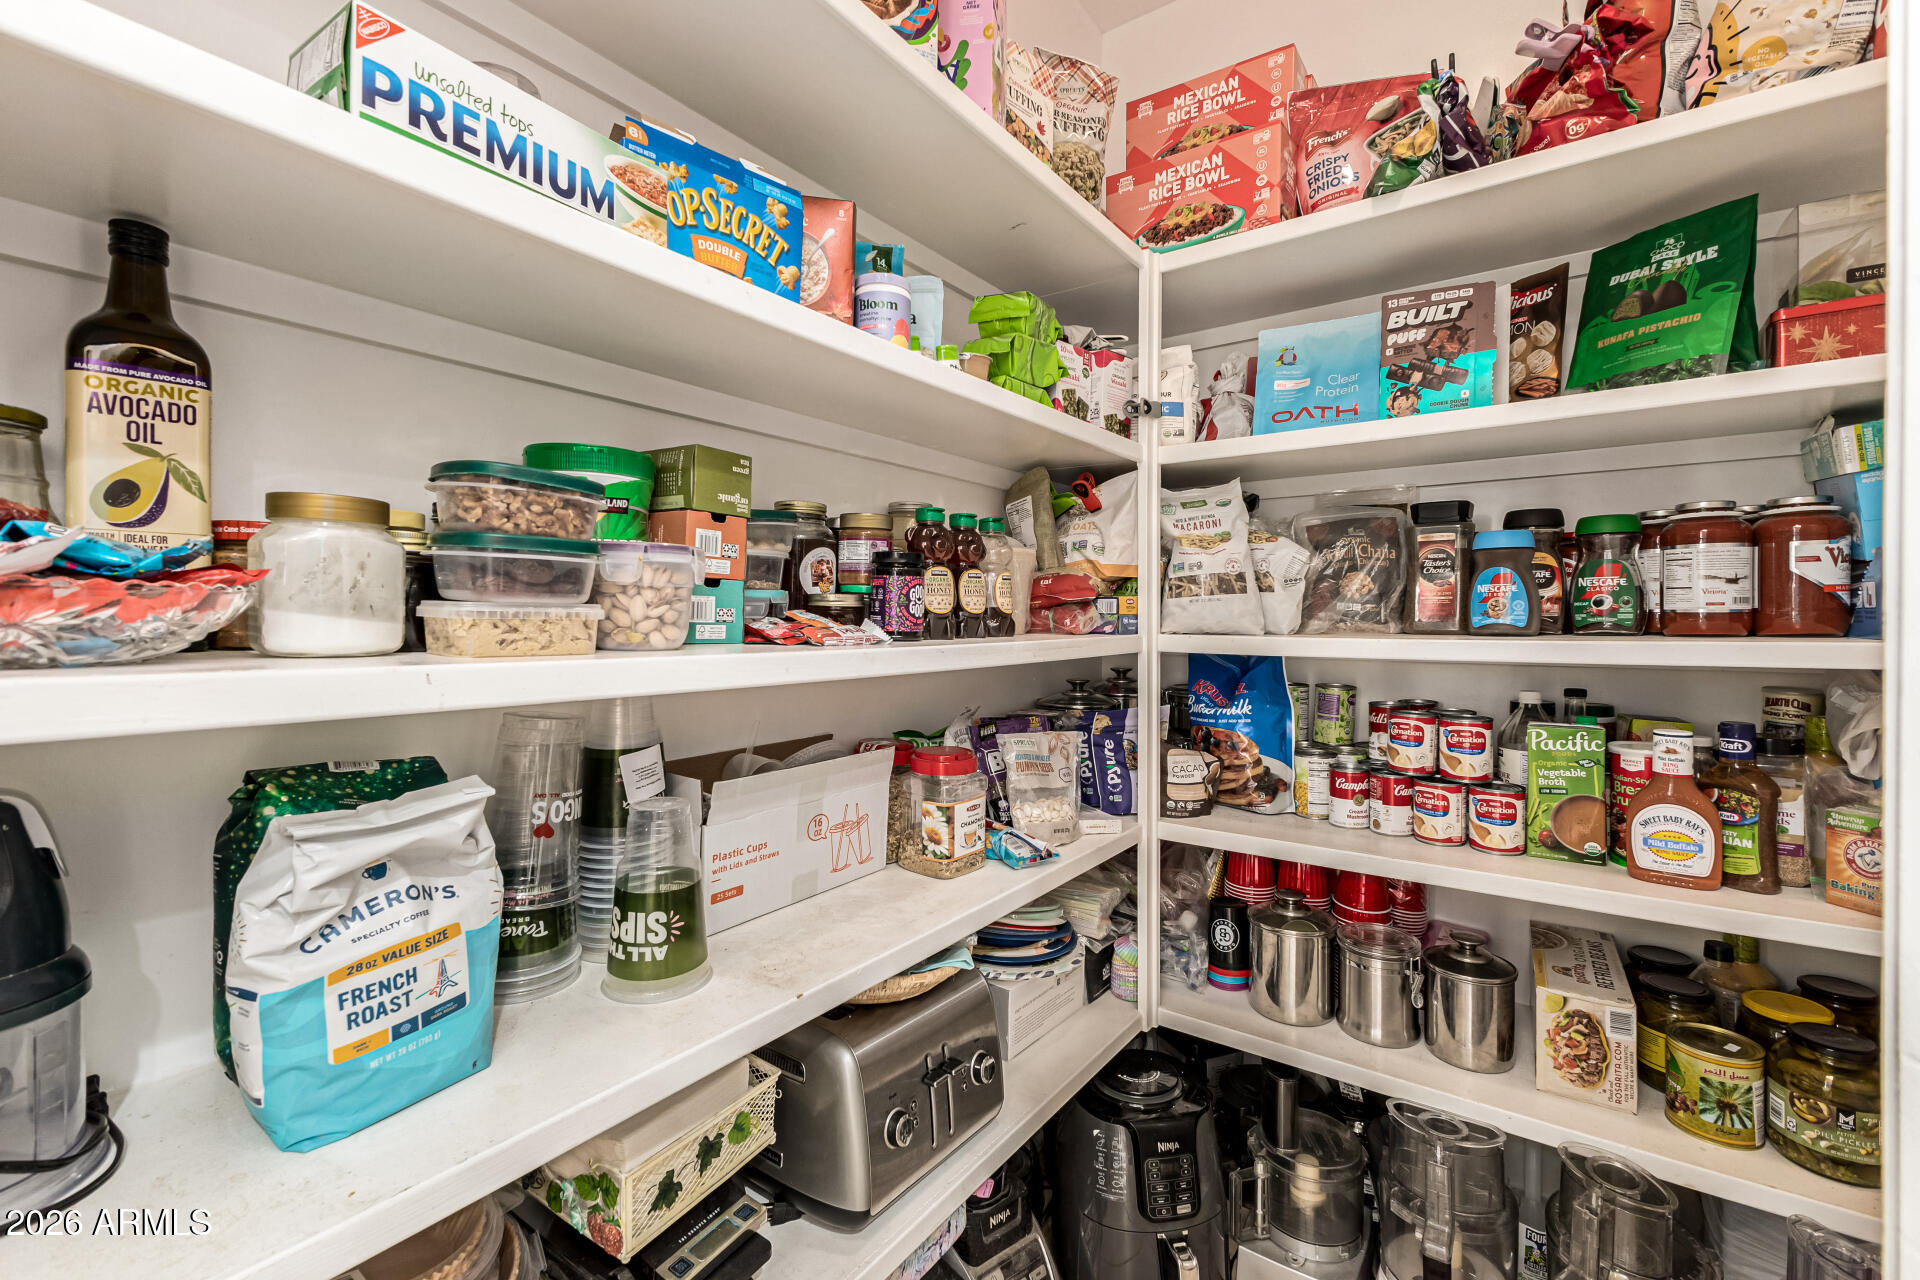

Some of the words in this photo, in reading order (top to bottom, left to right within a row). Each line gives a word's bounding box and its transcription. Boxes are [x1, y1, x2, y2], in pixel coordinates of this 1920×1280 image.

[361, 21, 388, 35] NABISCO
[414, 61, 492, 116] unsalted
[500, 103, 534, 137] tops
[1173, 75, 1239, 109] MEXICAN
[1056, 101, 1088, 114] ORGANIC
[1167, 104, 1199, 126] RICE
[1203, 89, 1246, 116] BOWL
[361, 56, 615, 221] PREMIUM
[1306, 128, 1351, 151] French's
[1154, 152, 1223, 186] MEXICAN
[1305, 152, 1350, 178] CRISPY
[1149, 182, 1181, 202] RICE
[1185, 166, 1230, 192] BOWL
[1307, 164, 1342, 189] FRIED
[698, 240, 741, 262] DOUBLE
[700, 252, 738, 274] BUTTER
[1609, 263, 1657, 287] DUBAI
[1661, 246, 1719, 271] STYLE
[859, 299, 898, 311] Bloom
[1386, 300, 1468, 330] BUILT
[1387, 328, 1427, 346] PUFF
[1597, 330, 1635, 349] KUNAFA
[1638, 313, 1702, 336] PISTACHIO
[74, 362, 100, 371] MADE
[102, 365, 127, 375] FROM
[128, 369, 151, 379] PURE
[153, 373, 193, 385] AVOCADO
[195, 379, 207, 388] OIL
[1327, 372, 1360, 385] Clear
[84, 374, 200, 403] ORGANIC
[1315, 384, 1360, 397] Protein
[87, 392, 197, 425] AVOCADO
[1271, 403, 1359, 424] OATH
[126, 420, 162, 445] OIL
[1072, 521, 1098, 531] OATS
[1173, 519, 1222, 532] MACARONI
[124, 534, 149, 544] IDEAL
[152, 534, 168, 544] FOR
[1422, 559, 1451, 567] Taster's
[1423, 566, 1451, 574] Choice
[1391, 725, 1423, 737] Carnation
[1448, 732, 1485, 744] Carnation
[1528, 728, 1606, 752] Pacific
[1719, 740, 1743, 750] Kraft
[1104, 738, 1122, 785] pyure
[1171, 764, 1205, 775] CACAO
[1538, 759, 1567, 767] Organic
[1537, 768, 1587, 778] Vegetable
[1538, 778, 1566, 786] Broth
[1415, 793, 1447, 806] Carnation
[1477, 801, 1515, 814] Carnation
[814, 817, 823, 827] 16
[1639, 815, 1661, 828] SWEET
[1663, 815, 1685, 824] BABY
[712, 847, 743, 863] Plastic
[746, 841, 768, 856] Cups
[1647, 839, 1665, 848] Mild
[1667, 841, 1699, 852] Buffalo
[711, 864, 728, 876] with
[730, 860, 743, 870] Lids
[744, 856, 757, 867] and
[759, 850, 779, 862] Straws
[1829, 880, 1875, 900] Baking
[300, 884, 457, 954] CAMERON'S
[351, 920, 401, 944] SPECIALTY
[403, 909, 429, 925] COFFEE
[345, 961, 364, 977] 28
[365, 958, 379, 969] OZ
[382, 938, 423, 964] VALUE
[425, 928, 449, 950] SIZE
[632, 944, 668, 962] ALL
[1586, 939, 1608, 961] BEANS
[1591, 960, 1616, 990] REFRIED
[337, 967, 419, 1011] FRENCH
[346, 989, 414, 1031] ROAST
[370, 1057, 384, 1069] NET
[385, 1050, 396, 1062] WT
[408, 1040, 417, 1051] OZ
[1614, 1041, 1623, 1105] ROSARITA.COM
[1703, 1067, 1727, 1078] التمر
[1729, 1072, 1750, 1081] عسل
[1157, 1141, 1180, 1153] NINJA
[1814, 1129, 1835, 1141] DILL
[1839, 1136, 1877, 1149] PICKLES
[989, 1208, 1011, 1229] NINJA
